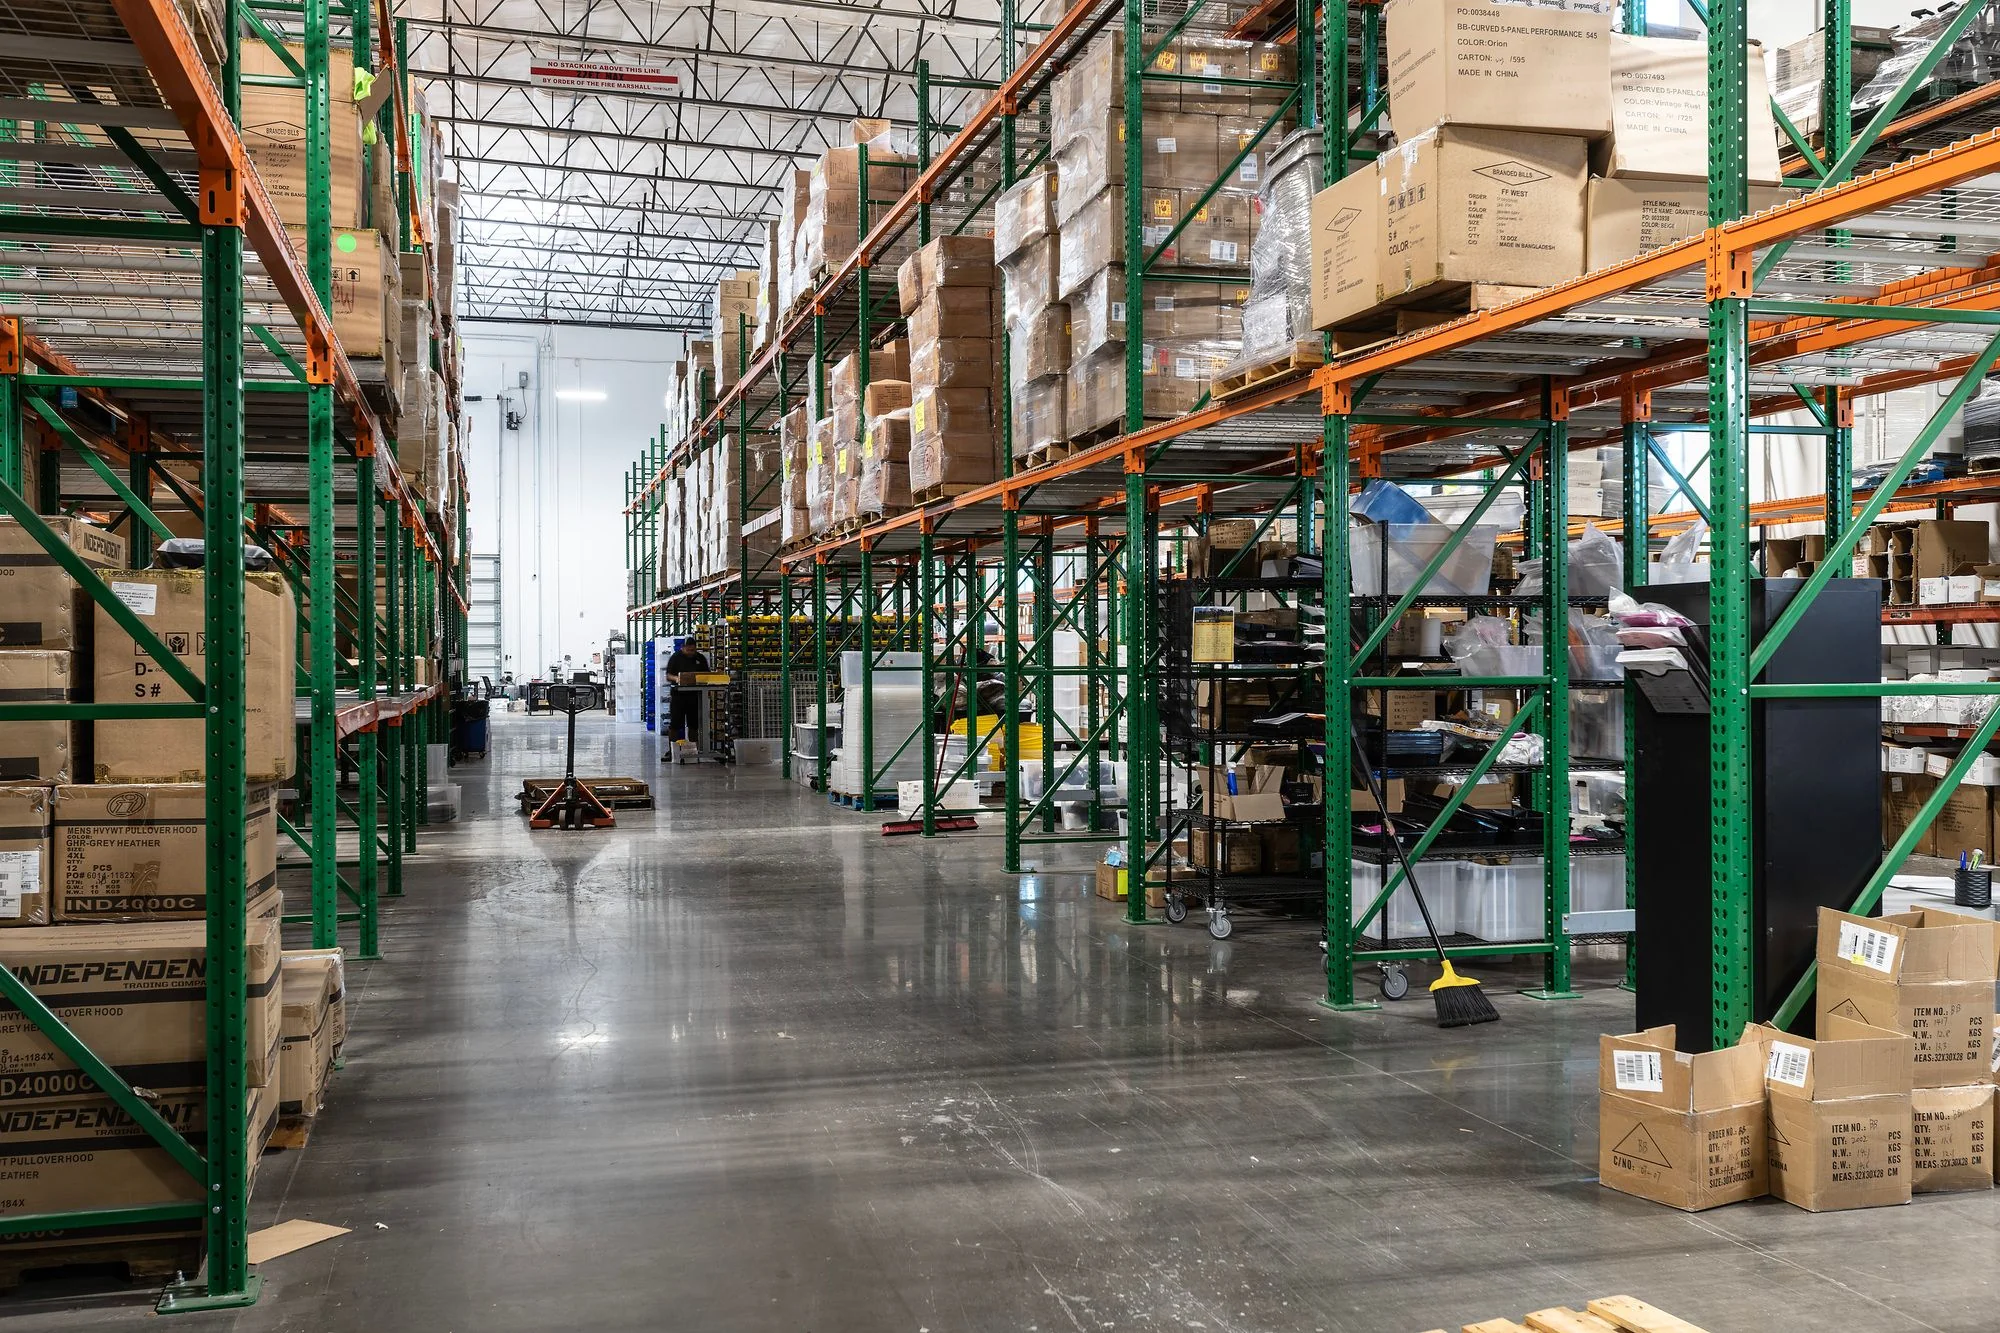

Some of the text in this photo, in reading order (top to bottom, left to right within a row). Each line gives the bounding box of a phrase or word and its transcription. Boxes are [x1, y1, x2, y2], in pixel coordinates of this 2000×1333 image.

[1457, 8, 1500, 17] PO:0038448
[1457, 23, 1500, 33] BB-CURVED
[1500, 26, 1530, 35] 5-PANEL
[1530, 27, 1582, 38] PERFORMANCE
[1621, 72, 1665, 80] PO:0037493
[1622, 85, 1665, 94] BB-CURVED
[1666, 88, 1695, 96] 5-PANEL
[1625, 111, 1660, 119] CARTON:
[1388, 240, 1409, 256] COLOR
[84, 532, 120, 560] INDEPENDENT
[135, 684, 161, 697] S #
[66, 898, 196, 911] IND4000C
[12, 957, 207, 986] INDEPENDEN
[123, 981, 168, 989] TRADING
[94, 1007, 124, 1016] HOOD
[1914, 1007, 1948, 1016] ITEM NO.:
[1970, 1017, 1982, 1025] PCS
[1913, 1028, 1982, 1039] N.W.: KGS
[1968, 1040, 1981, 1048] KGS
[0, 1103, 200, 1133] NDEPENDNT
[1914, 1113, 1932, 1121] ITEM
[1935, 1112, 1950, 1120] NO.:
[95, 1128, 140, 1136] TRADING
[1832, 1123, 1866, 1133] ITEM NO.:
[1915, 1120, 1984, 1133] QTY: PCS
[1709, 1129, 1725, 1140] ORDER
[1832, 1131, 1901, 1145] QTY: PCS
[1915, 1132, 1984, 1145] N.W.: KGS
[1709, 1143, 1719, 1152] QTY:
[1741, 1136, 1749, 1145] PCS
[1832, 1143, 1901, 1157] N.W.: KGS
[1709, 1154, 1723, 1164] N.W.:
[1741, 1147, 1750, 1157] KGS
[1915, 1144, 1984, 1157] G.W.: KGS
[10, 1154, 94, 1166] PULLOVER HOOD
[1613, 1155, 1635, 1171] C/NO:
[1741, 1159, 1750, 1169] KGS
[1832, 1155, 1901, 1169] G.W.: KGS
[1915, 1156, 1981, 1168] MEAS:32X30X28 CM
[1832, 1168, 1898, 1181] MEAS:32X30X28 CM
